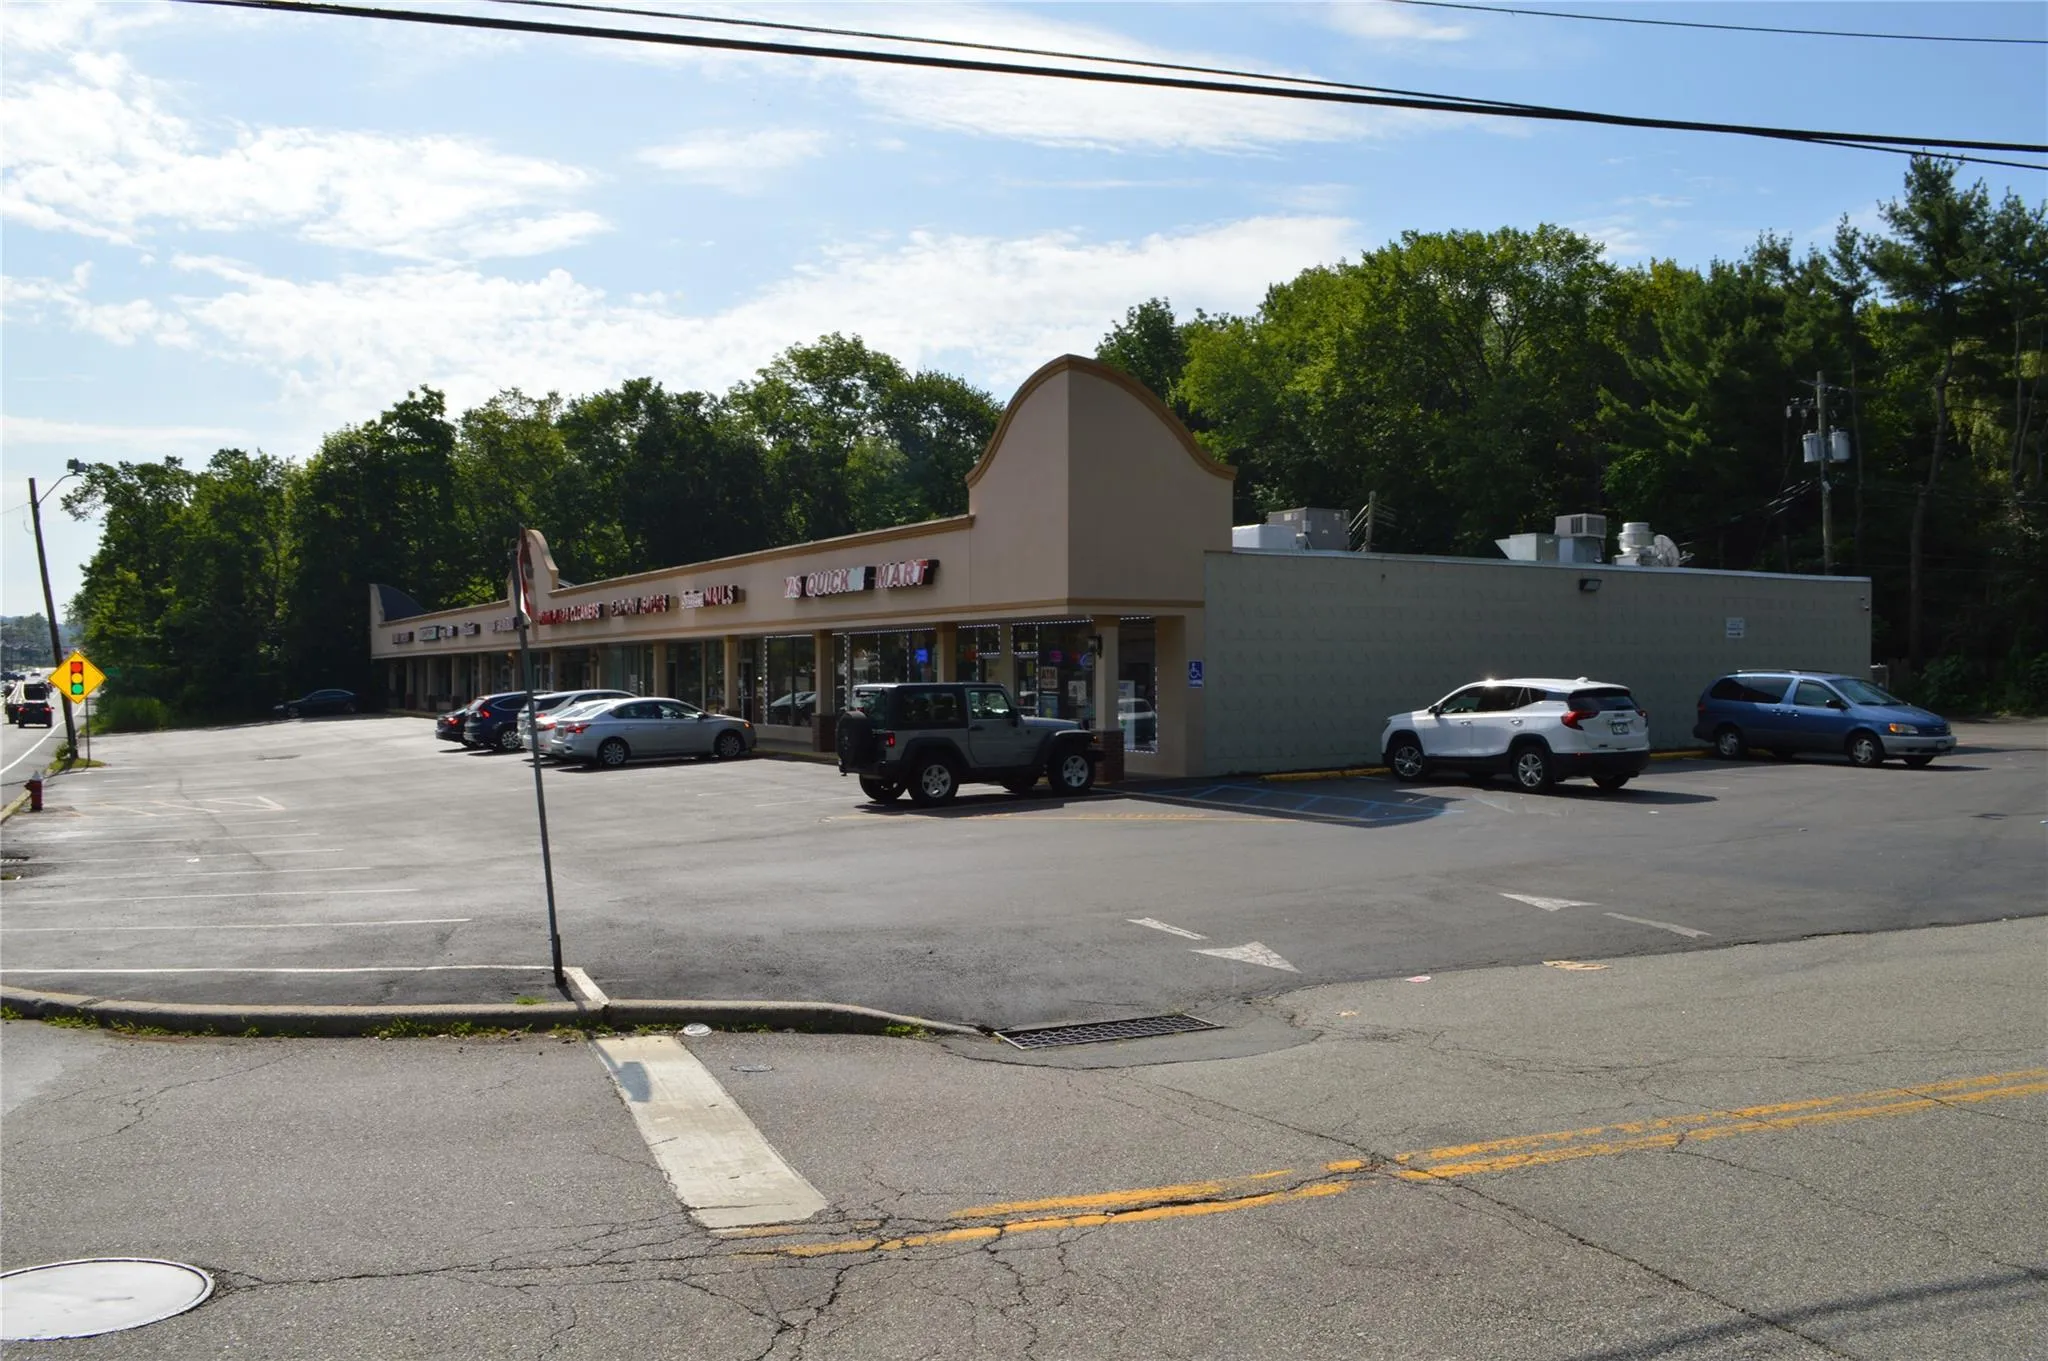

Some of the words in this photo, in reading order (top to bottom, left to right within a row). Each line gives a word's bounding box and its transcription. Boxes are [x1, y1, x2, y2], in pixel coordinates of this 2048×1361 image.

[805, 567, 850, 597] QUICK
[875, 559, 929, 589] MART
[704, 585, 734, 605] NAILS
[570, 603, 600, 622] CLEANERS
[1041, 668, 1056, 680] ATM
